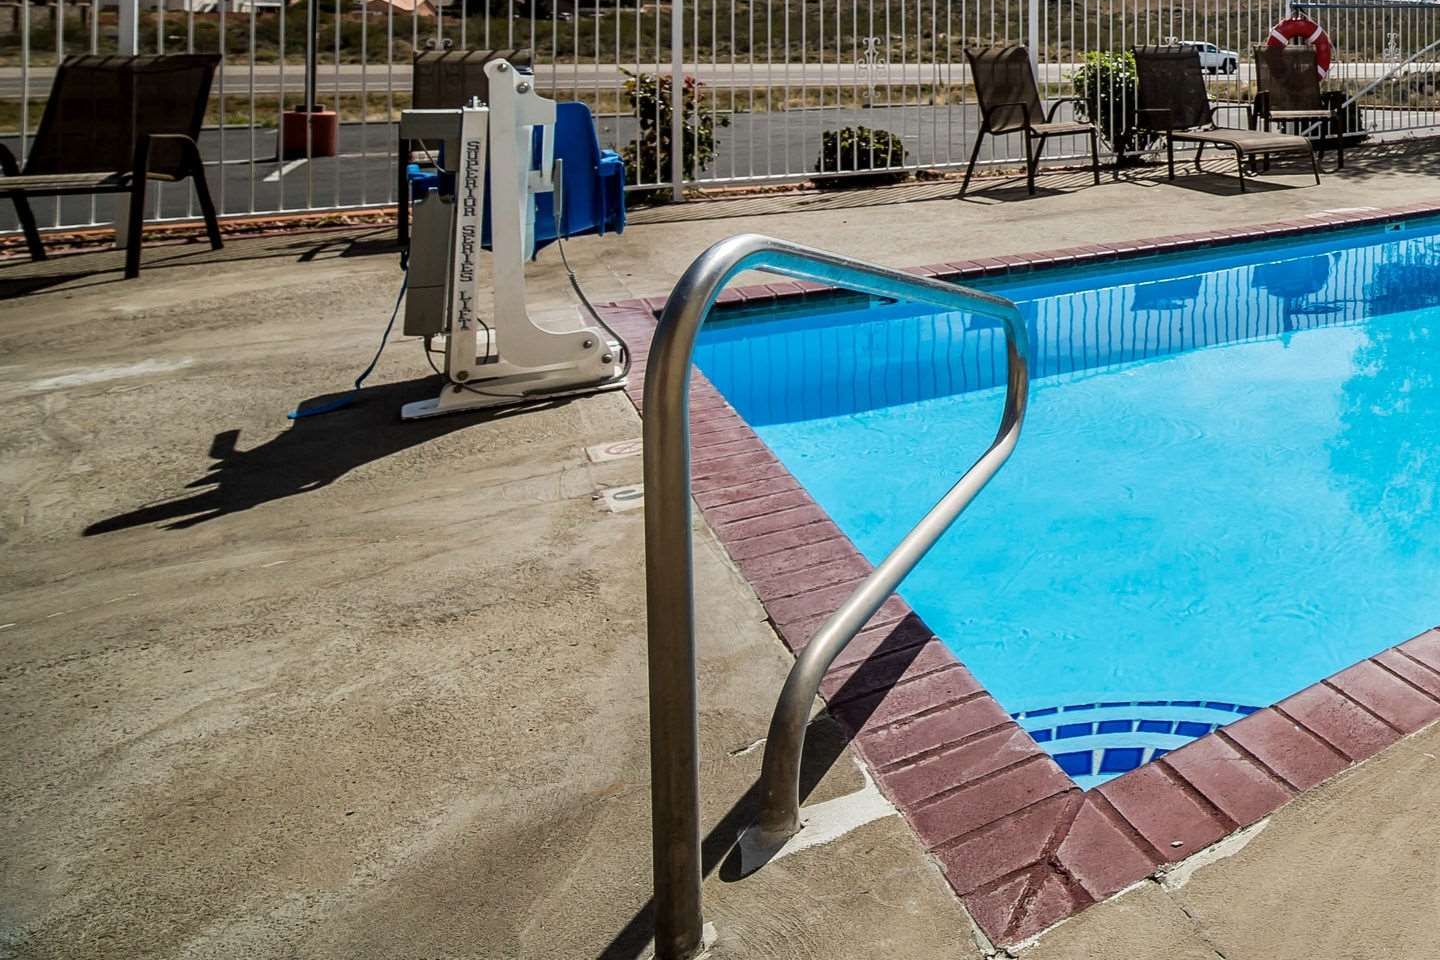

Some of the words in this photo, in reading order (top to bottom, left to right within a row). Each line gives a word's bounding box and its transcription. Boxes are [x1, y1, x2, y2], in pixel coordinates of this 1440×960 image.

[463, 141, 481, 216] SUPERIOR
[460, 225, 476, 282] SERIES
[458, 290, 472, 330] LIFT
